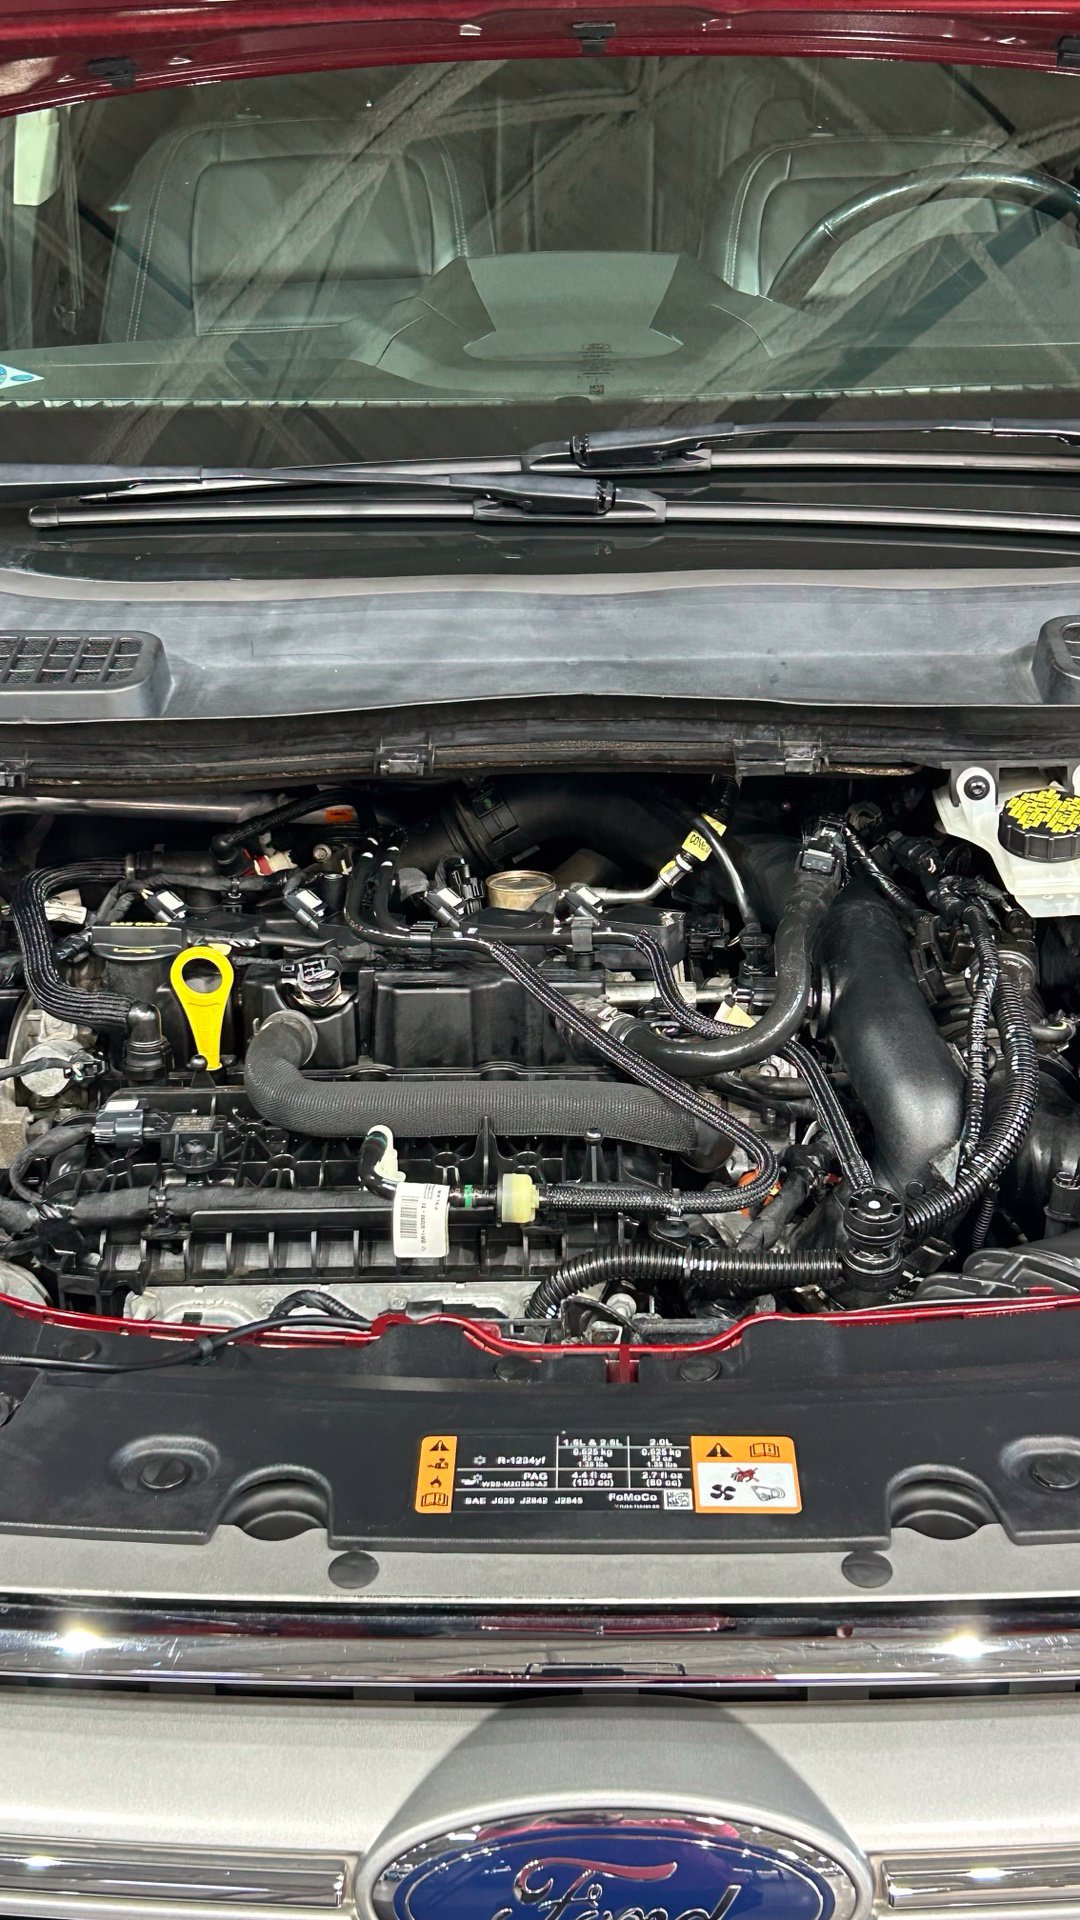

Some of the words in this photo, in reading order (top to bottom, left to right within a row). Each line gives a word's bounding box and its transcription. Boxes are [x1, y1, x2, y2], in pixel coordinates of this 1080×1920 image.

[649, 1438, 673, 1446] 2.0L
[573, 1448, 598, 1456] 0.625
[601, 1448, 613, 1457] kg
[641, 1448, 667, 1456] 0.625
[669, 1448, 682, 1457] kg
[497, 1456, 546, 1466] R-1234yf
[523, 1472, 548, 1480] PAG
[608, 1493, 658, 1501] FoMoCo
[487, 1857, 742, 1920] Fd
